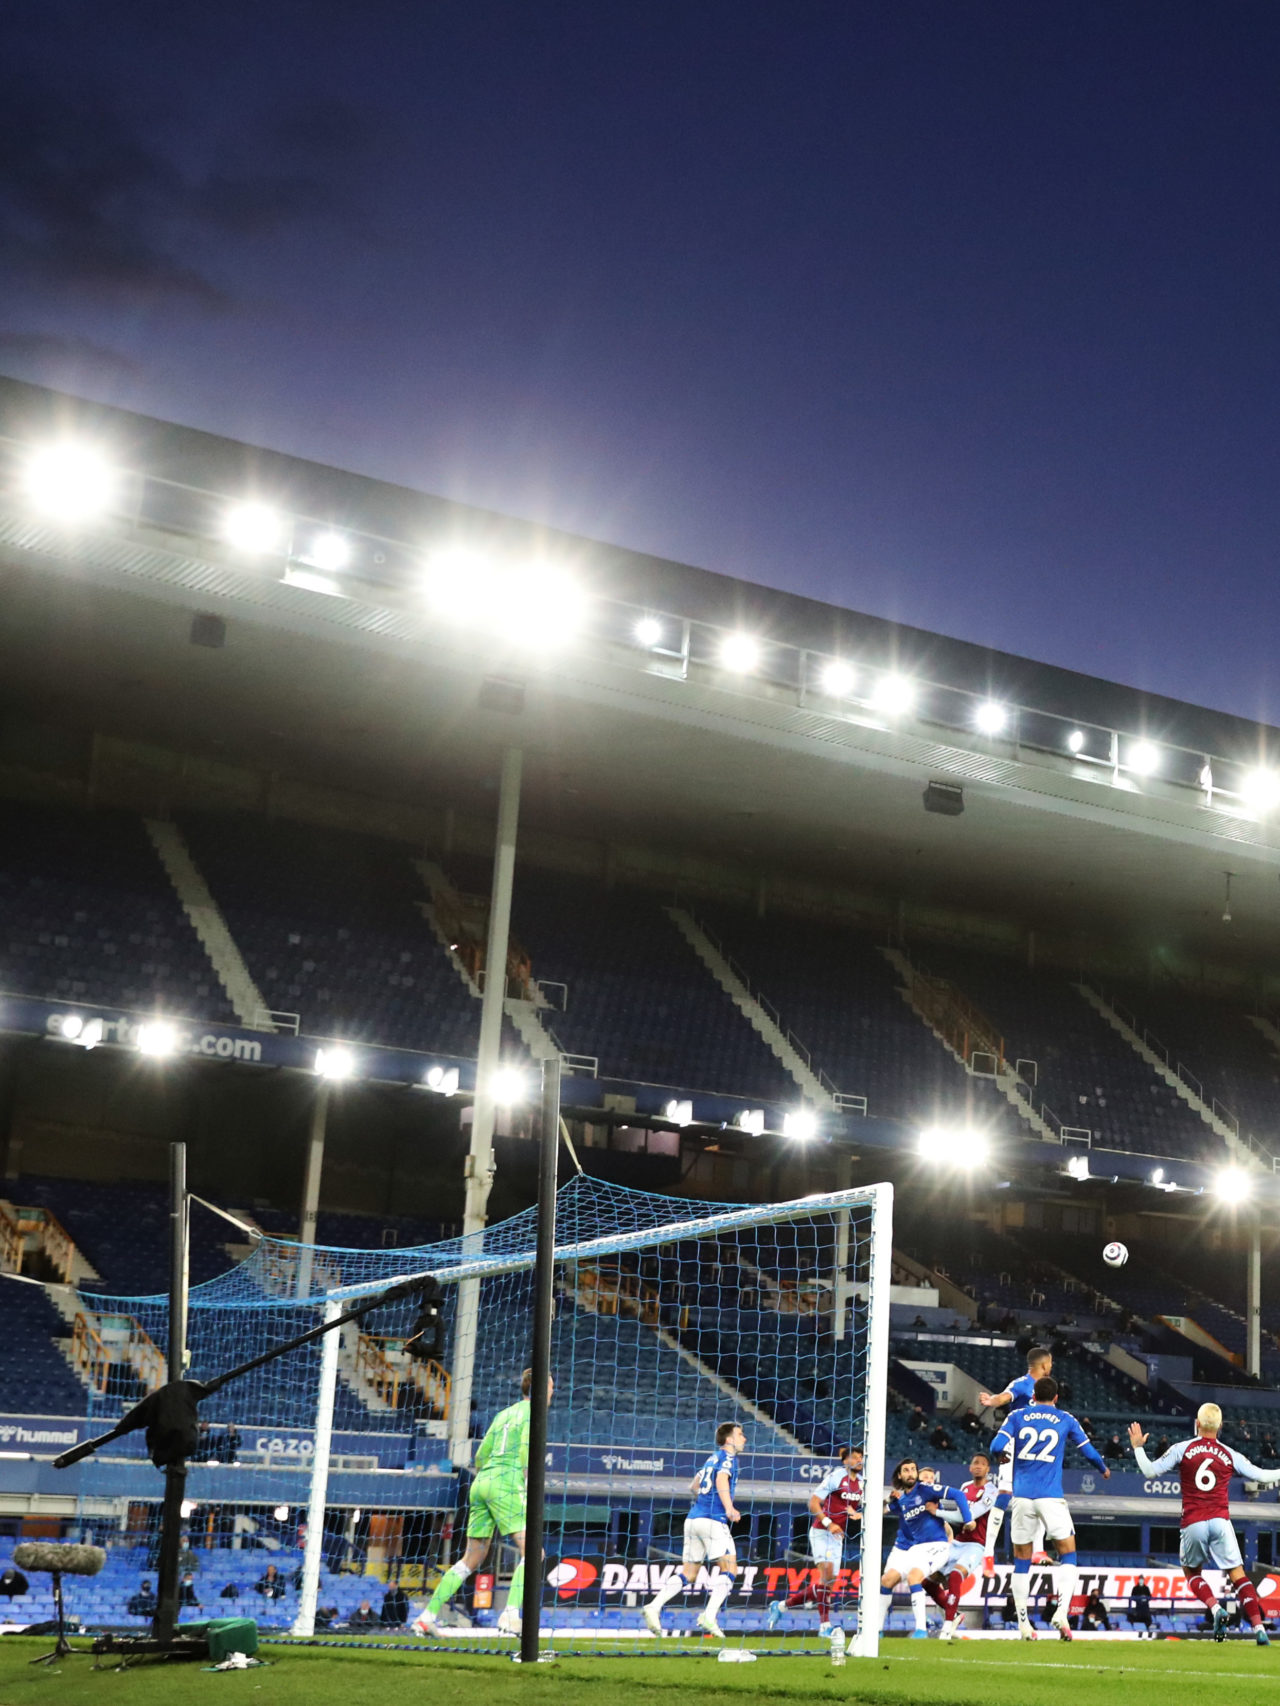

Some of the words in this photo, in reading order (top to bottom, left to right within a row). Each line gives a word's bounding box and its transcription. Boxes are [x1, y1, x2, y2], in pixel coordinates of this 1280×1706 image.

[47, 1013, 262, 1061] ertc.com
[1023, 1412, 1061, 1425] GODFREY
[16, 1427, 78, 1444] hummel
[256, 1437, 314, 1457] CAZO
[500, 1423, 510, 1455] 1
[1017, 1426, 1059, 1463] 22
[617, 1456, 664, 1472] hummel
[1185, 1444, 1219, 1460] DOUGLAS
[1218, 1450, 1233, 1467] LUIZ
[800, 1464, 833, 1480] CAZ
[1195, 1458, 1217, 1492] 6
[1143, 1480, 1181, 1494] CAZO
[601, 1563, 759, 1596] DAVNI
[980, 1572, 1109, 1599] DAATI
